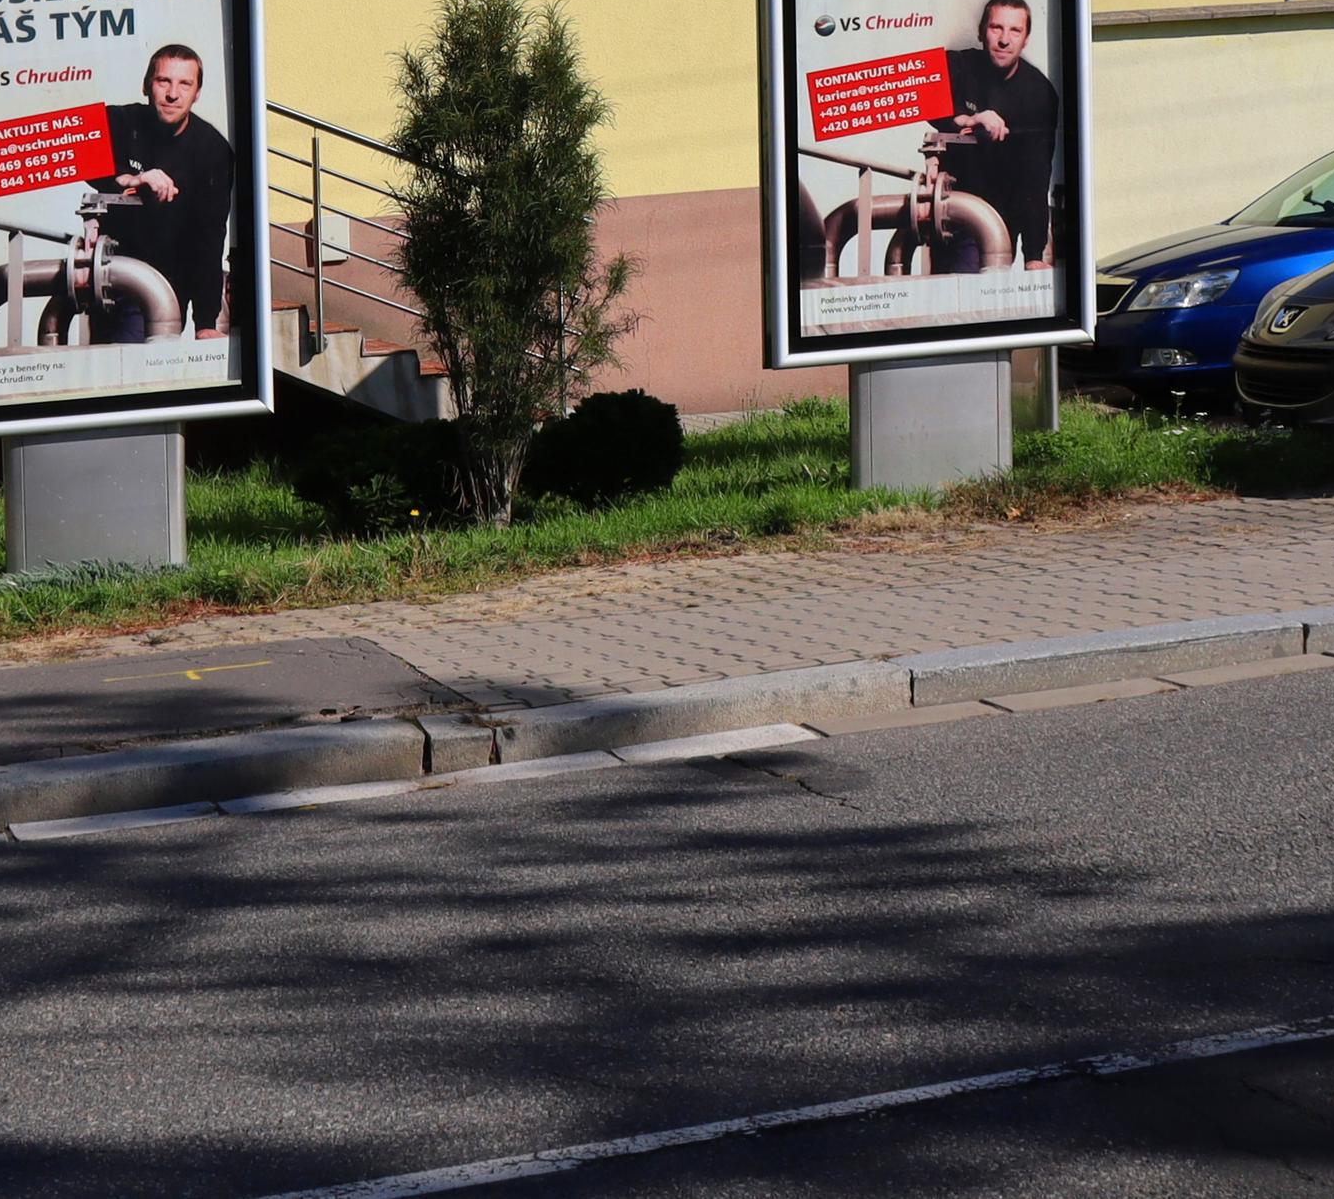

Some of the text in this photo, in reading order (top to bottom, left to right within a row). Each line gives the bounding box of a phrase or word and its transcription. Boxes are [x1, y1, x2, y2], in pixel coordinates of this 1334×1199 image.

[50, 6, 135, 40] TÝM
[840, 12, 933, 31] VS Chrudim
[16, 66, 92, 86] Chrudim
[815, 58, 925, 89] KONTAKTUJTE NÁS:
[817, 72, 941, 104] kariera@vschrudim.cz
[819, 91, 918, 118] +420 469 669 975
[52, 115, 83, 132] NÁS:
[821, 106, 919, 134] +420 844 114 455
[25, 154, 49, 170] 669
[51, 149, 75, 166] 975
[0, 175, 24, 191] 844
[27, 170, 51, 186] 114
[53, 165, 77, 181] 455
[865, 292, 896, 301] benefity
[820, 302, 890, 314] www.vschrudim.cz
[16, 363, 50, 372] benefity
